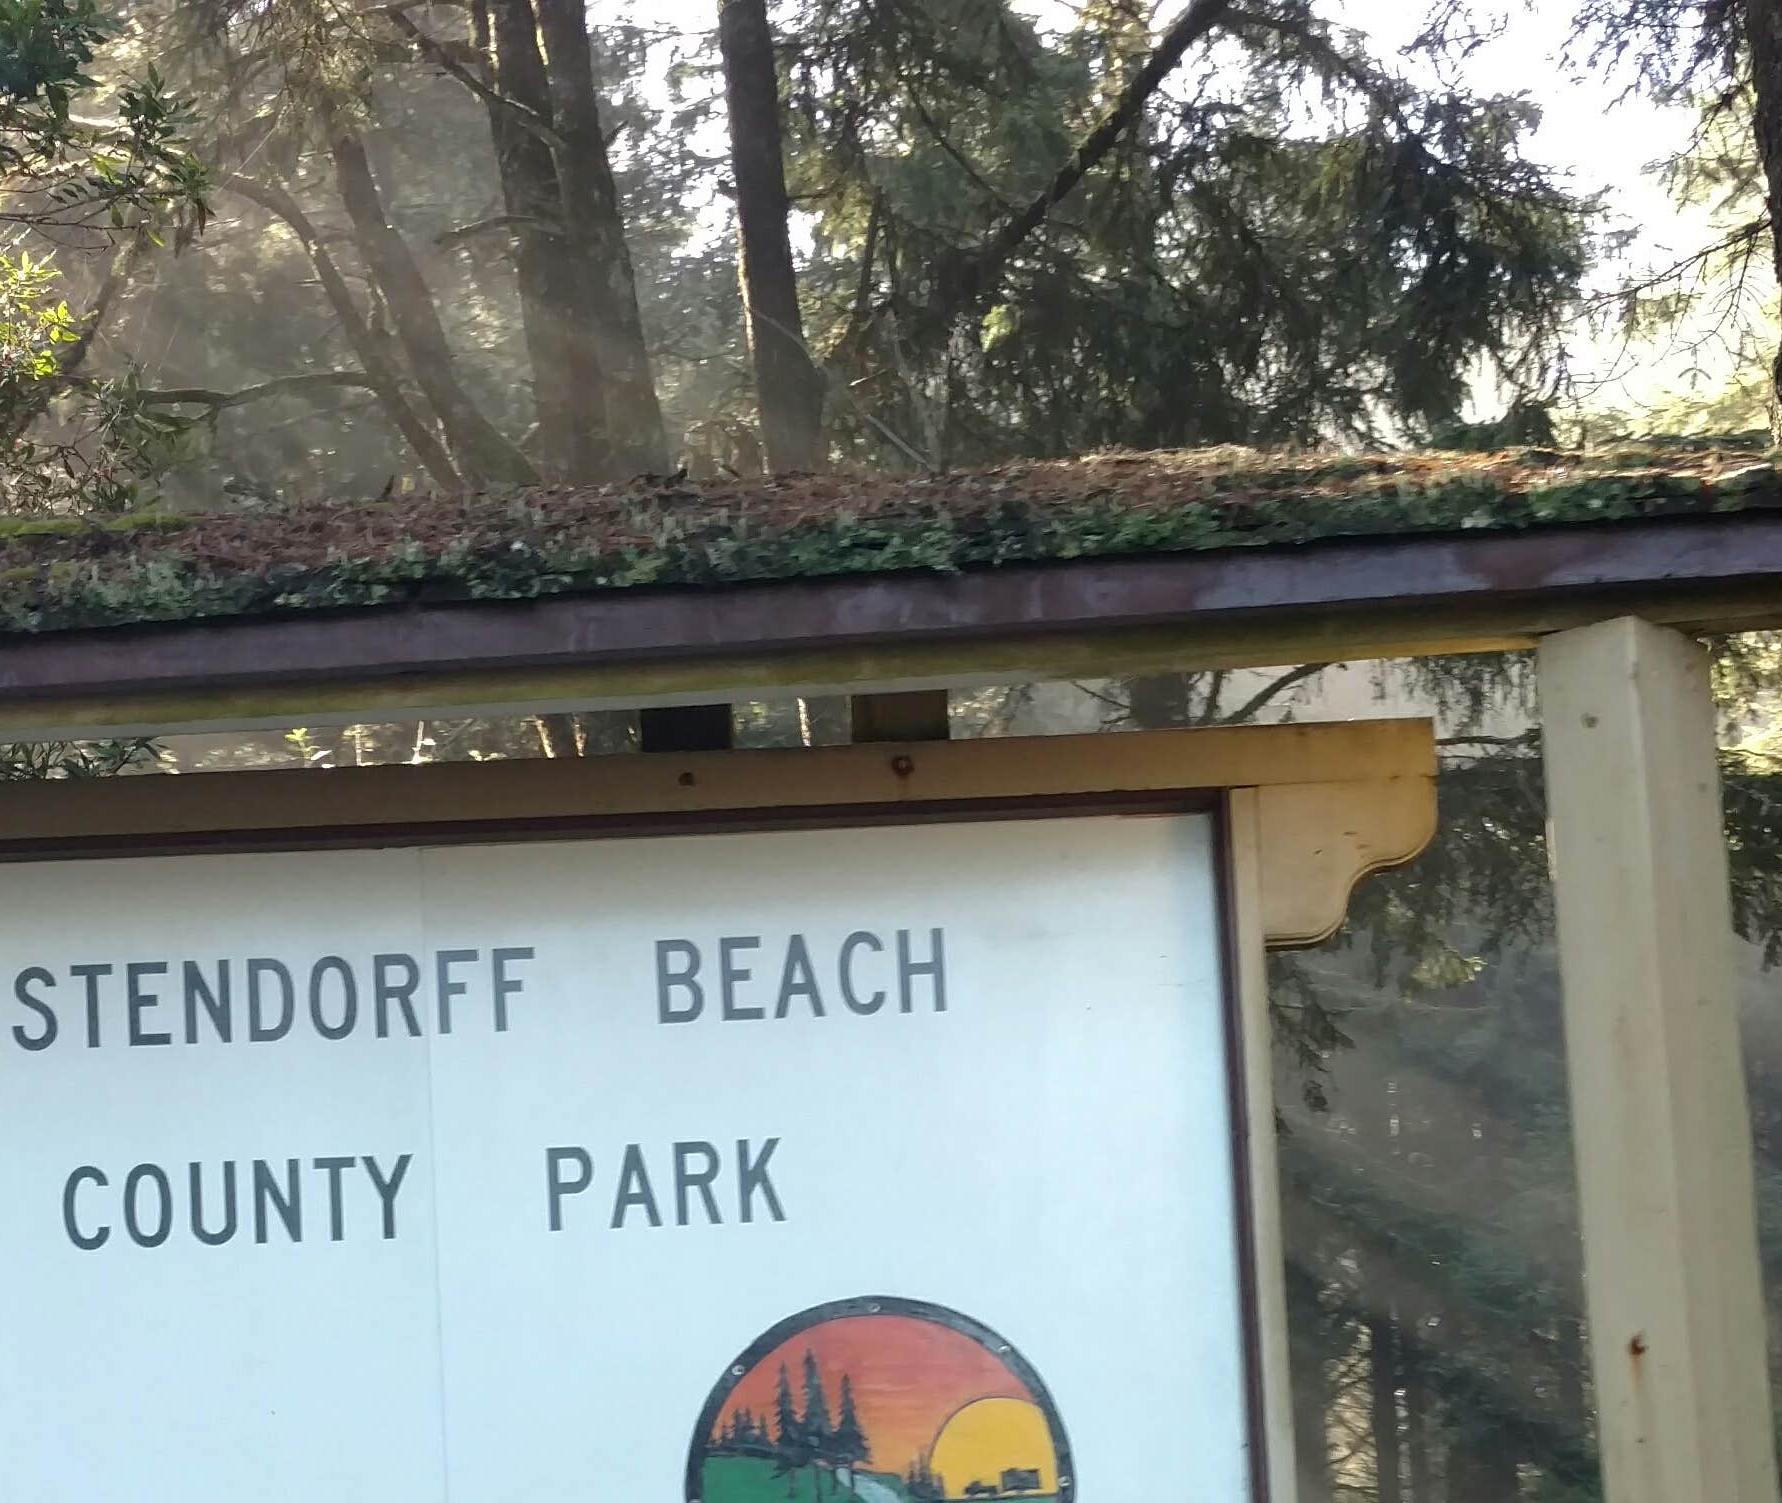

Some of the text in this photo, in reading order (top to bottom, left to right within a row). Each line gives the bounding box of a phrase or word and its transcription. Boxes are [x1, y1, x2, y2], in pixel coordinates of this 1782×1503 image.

[653, 926, 949, 1026] BEACH
[61, 1136, 789, 1252] COUNTY PARK
